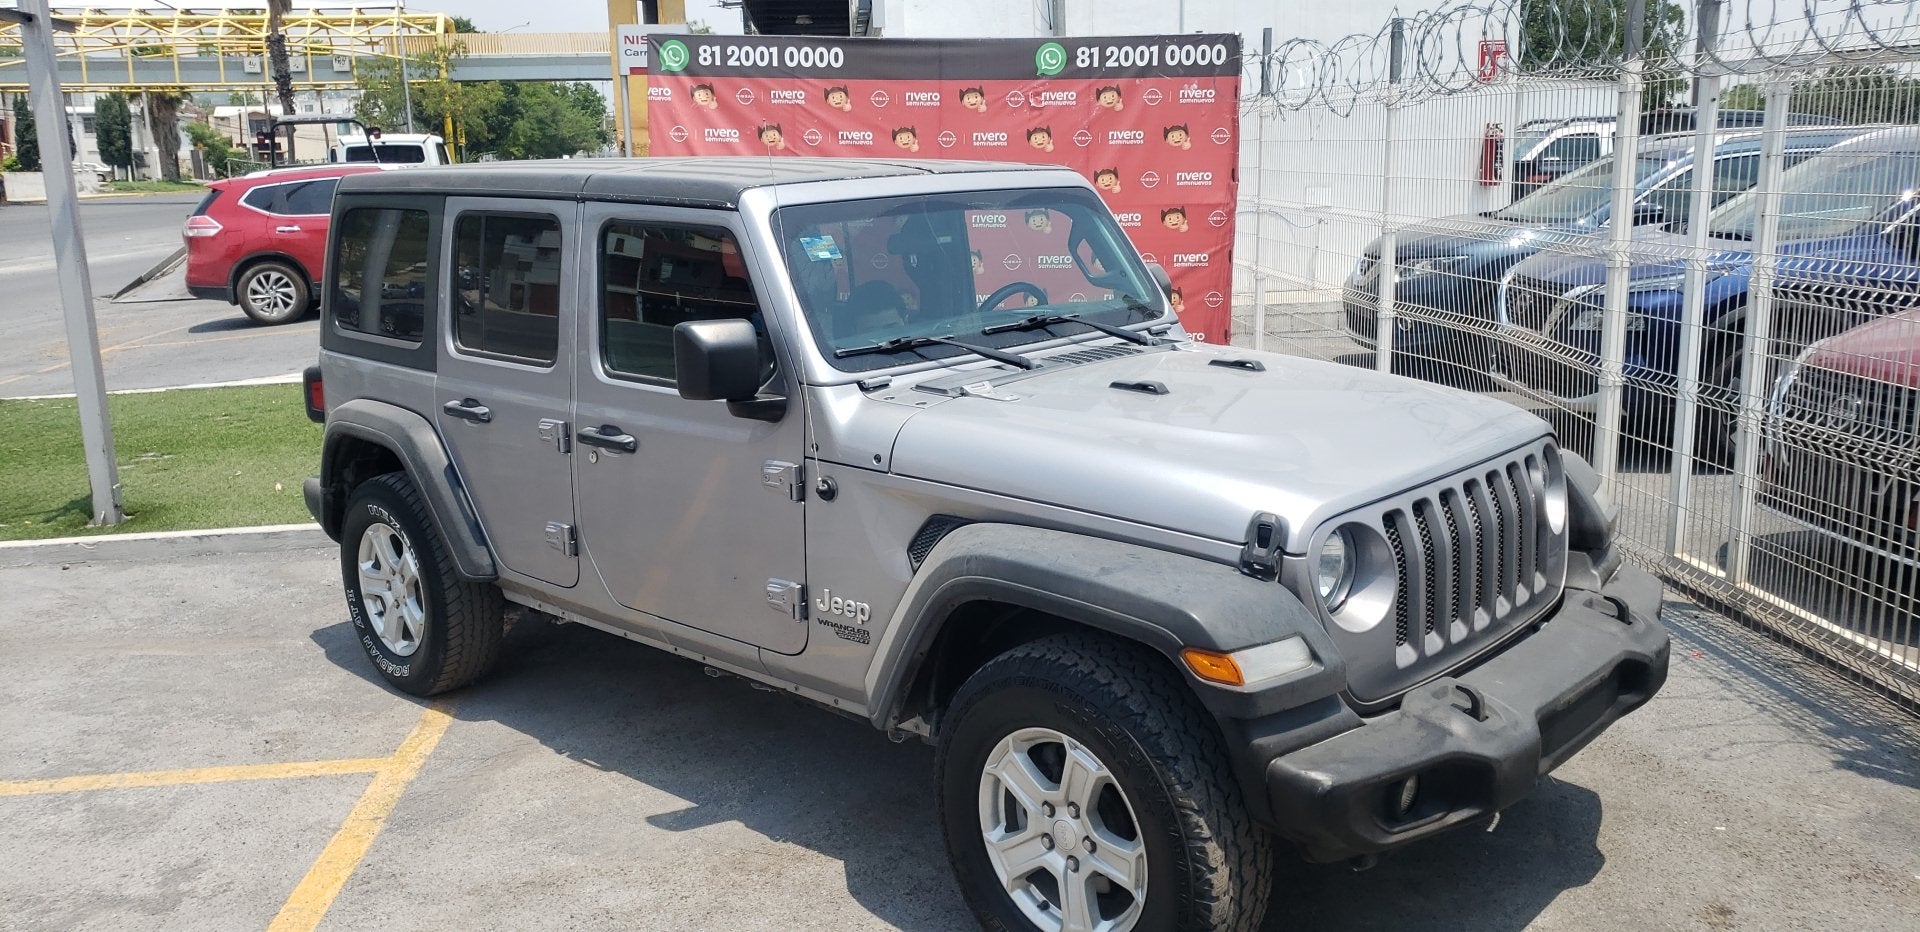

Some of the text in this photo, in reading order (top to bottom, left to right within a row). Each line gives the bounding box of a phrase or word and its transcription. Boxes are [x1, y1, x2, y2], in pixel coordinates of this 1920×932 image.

[698, 46, 844, 68] 81 2001 0000
[1076, 44, 1226, 68] 81 2001 0000
[770, 90, 805, 99] rivero
[905, 92, 940, 101] rivero
[1041, 91, 1076, 101] rivero
[1179, 89, 1215, 98] rivero
[704, 128, 739, 138] rivero
[838, 131, 873, 140] rivero
[972, 131, 1007, 141] rivero
[1108, 130, 1144, 140] rivero
[1176, 171, 1212, 181] rivero
[972, 214, 1006, 223] rivero
[1038, 255, 1072, 264] rivero
[1174, 253, 1208, 262] rivero
[816, 588, 872, 625] Jeep
[816, 618, 870, 637] WRANGLER
[362, 634, 410, 677] ROADIAN
